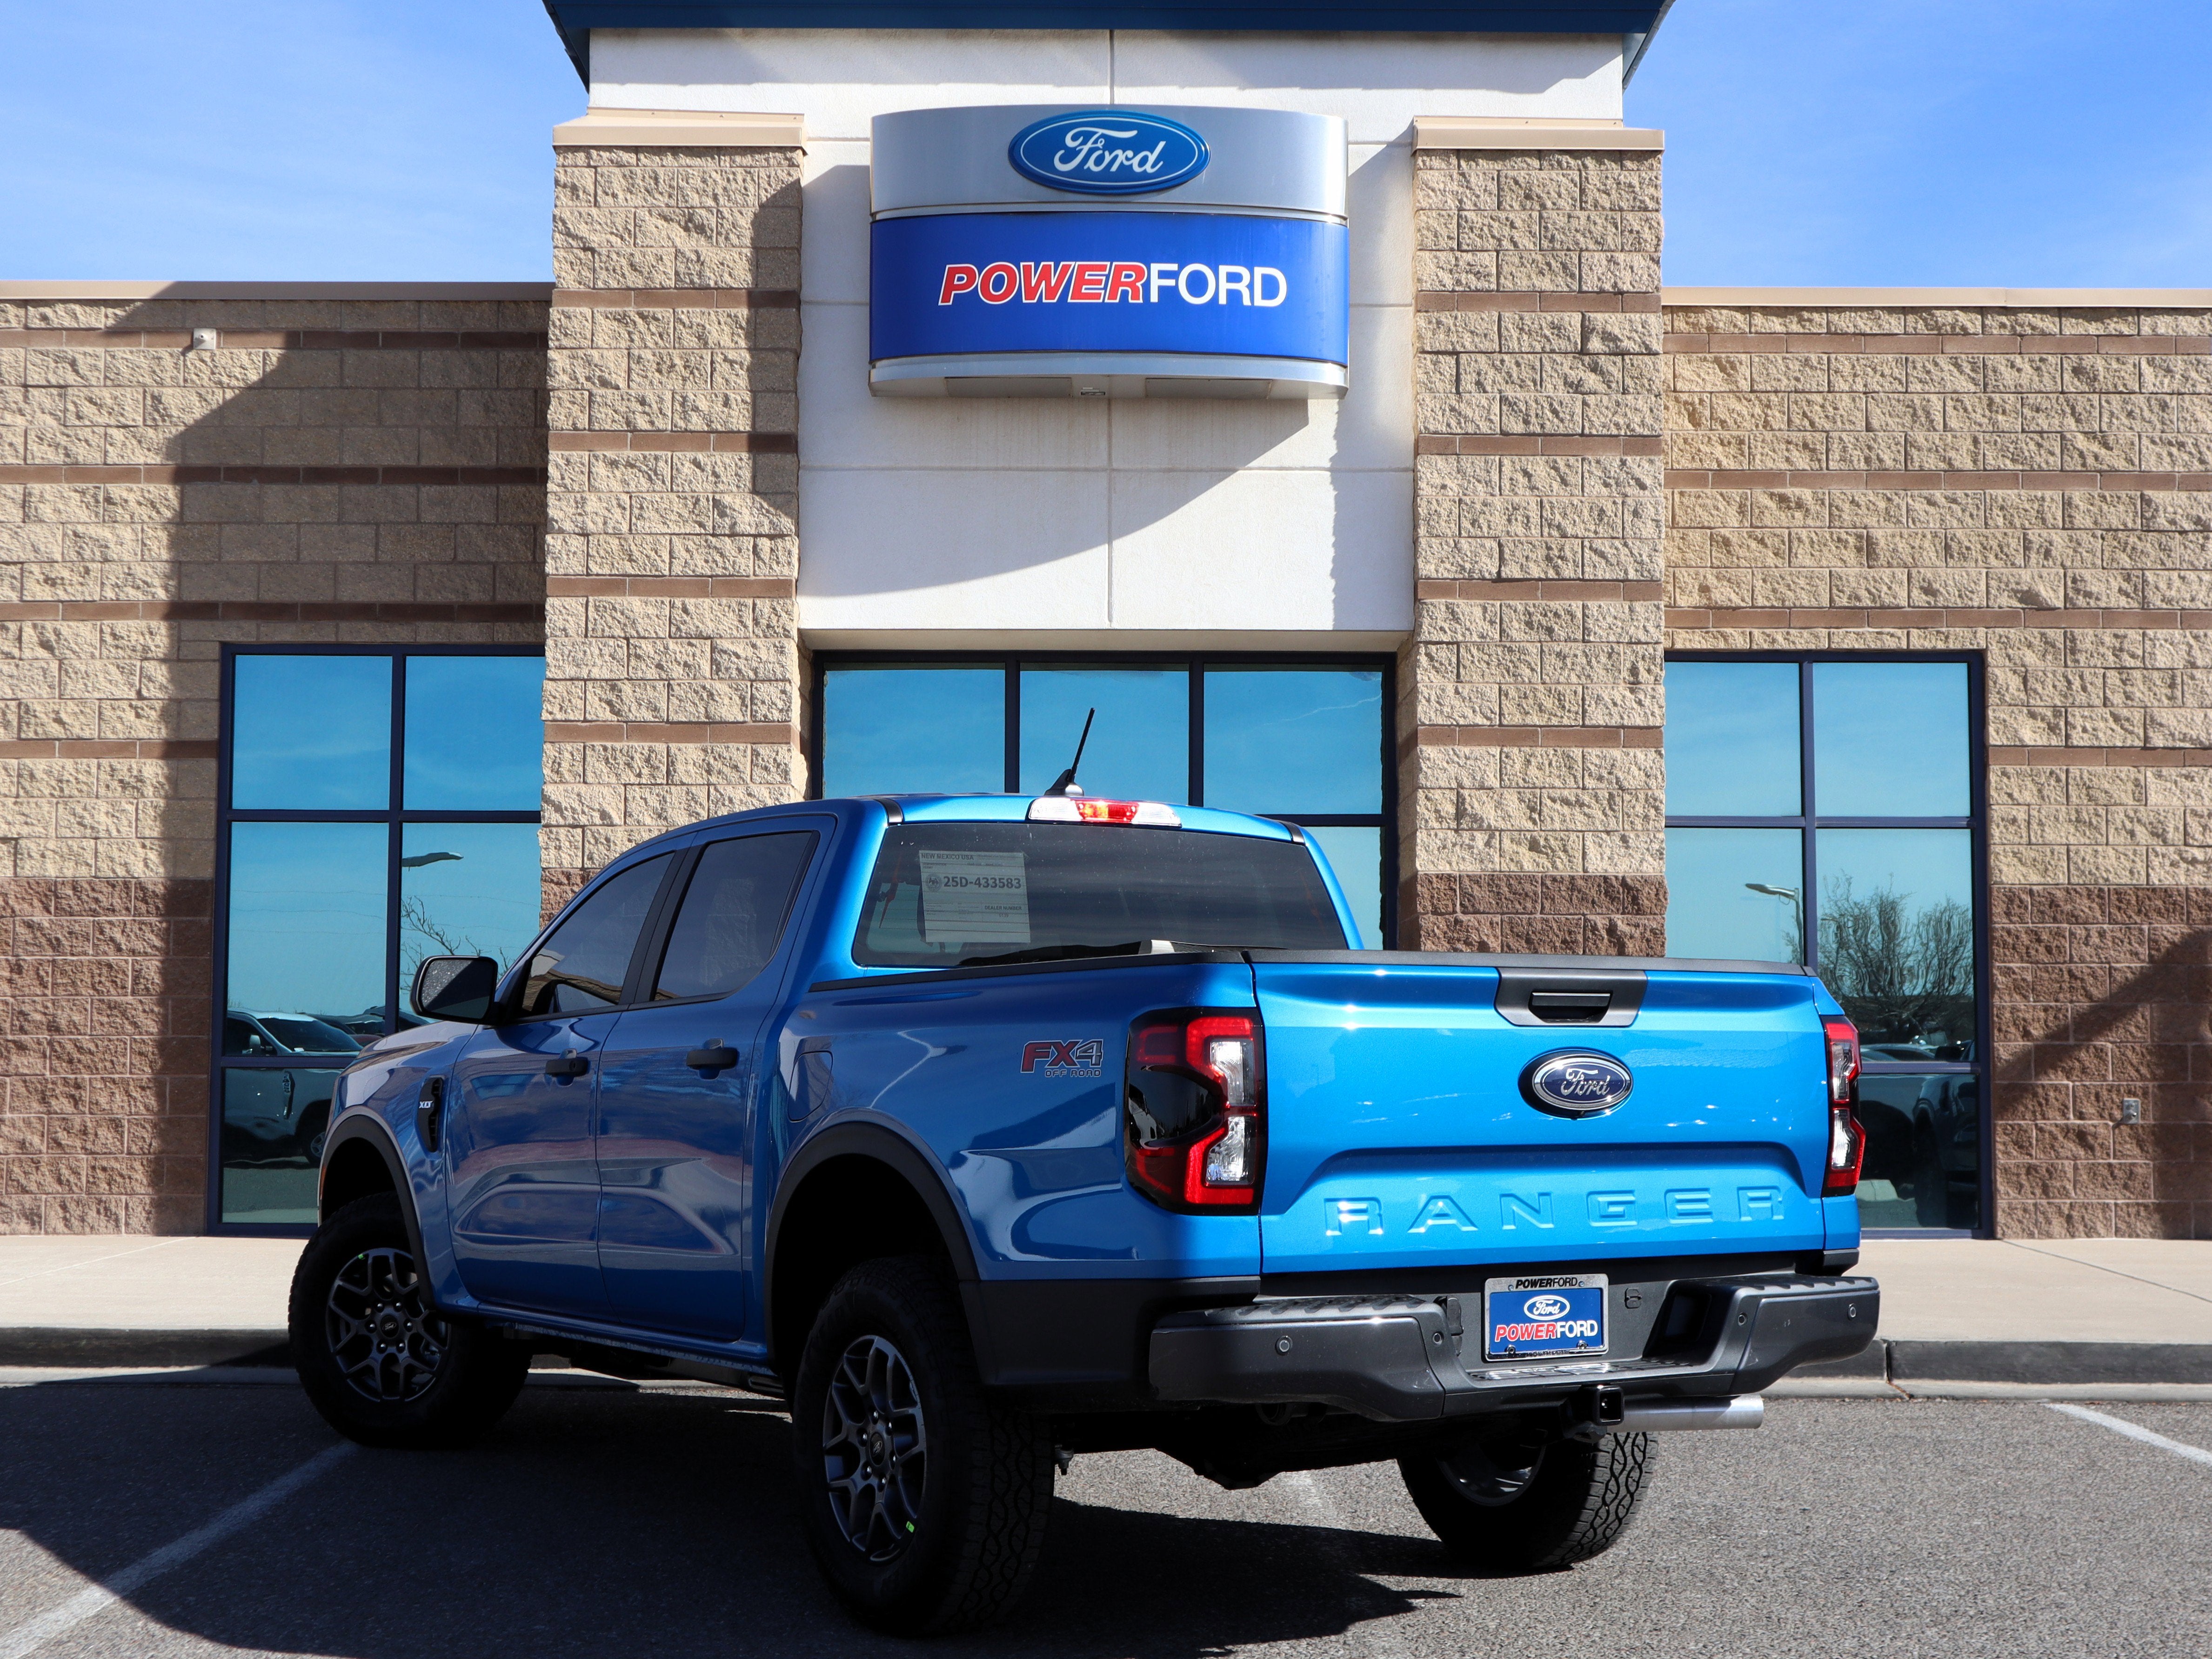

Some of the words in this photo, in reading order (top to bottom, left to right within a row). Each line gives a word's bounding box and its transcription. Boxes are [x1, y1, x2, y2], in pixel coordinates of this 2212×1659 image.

[1054, 126, 1166, 173] Ford
[938, 261, 1287, 307] POWERFORD
[943, 876, 1022, 889] 25D-433583
[1020, 1039, 1104, 1073] FX4
[1045, 1069, 1067, 1078] OFF
[1070, 1069, 1102, 1078] ROAD
[1561, 1068, 1611, 1096] Ford
[419, 1100, 433, 1109] XLT
[1323, 1186, 1784, 1236] RANGER
[1515, 1277, 1578, 1289] POWERFORD
[1533, 1300, 1560, 1315] Ford
[1495, 1320, 1598, 1343] POWERFORD
